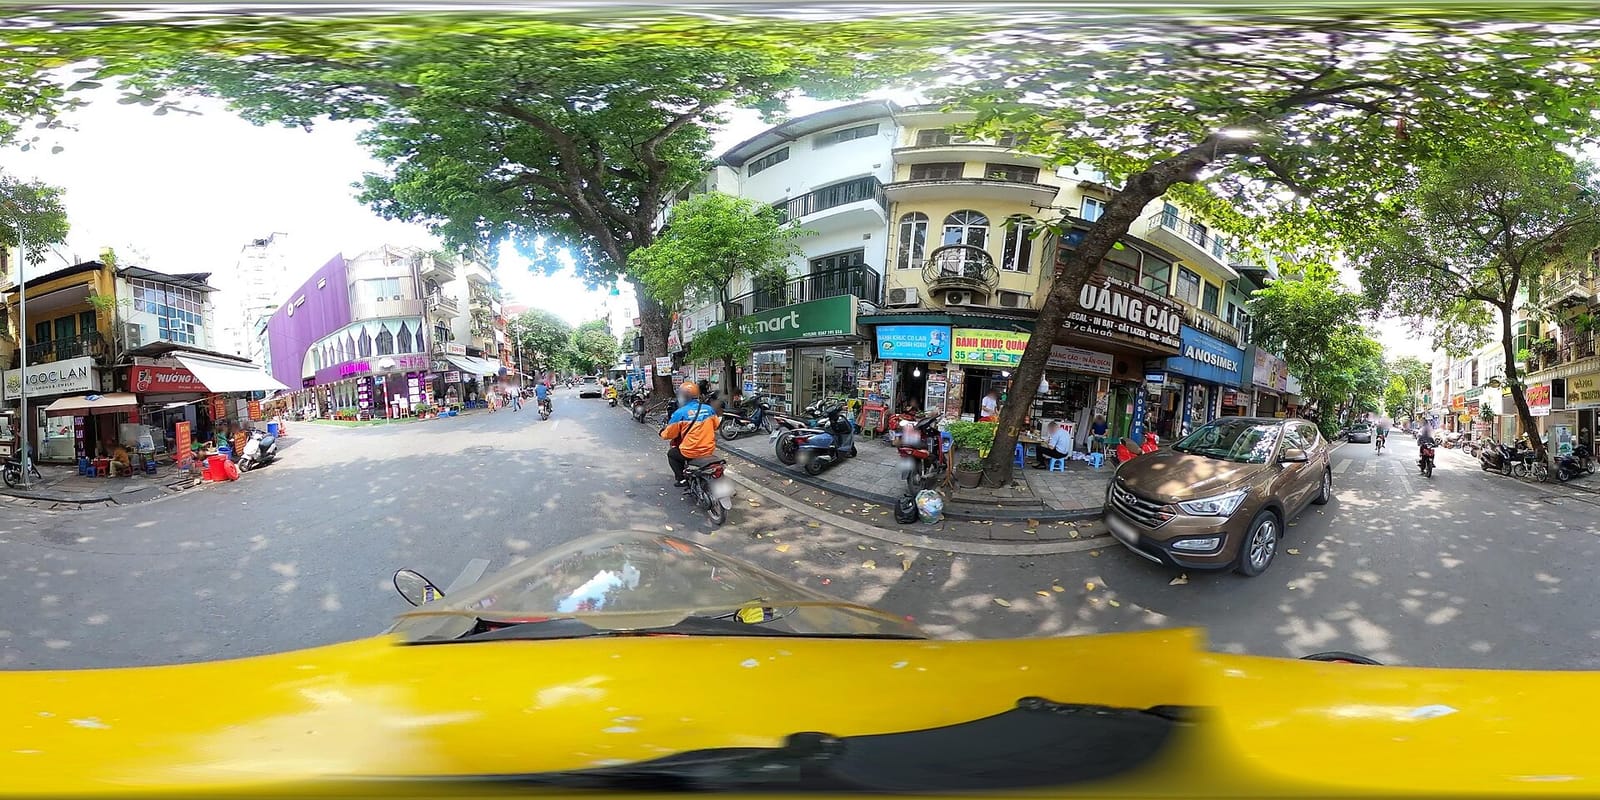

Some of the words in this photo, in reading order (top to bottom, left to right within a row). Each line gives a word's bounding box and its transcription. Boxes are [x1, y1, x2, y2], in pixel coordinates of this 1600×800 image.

[1079, 281, 1143, 323] UẢNG
[1145, 305, 1180, 336] CÁO
[954, 350, 966, 359] 35
[1049, 351, 1067, 360] UẢNG
[1184, 345, 1239, 373] ANOSIMEX
[60, 366, 87, 380] LAN
